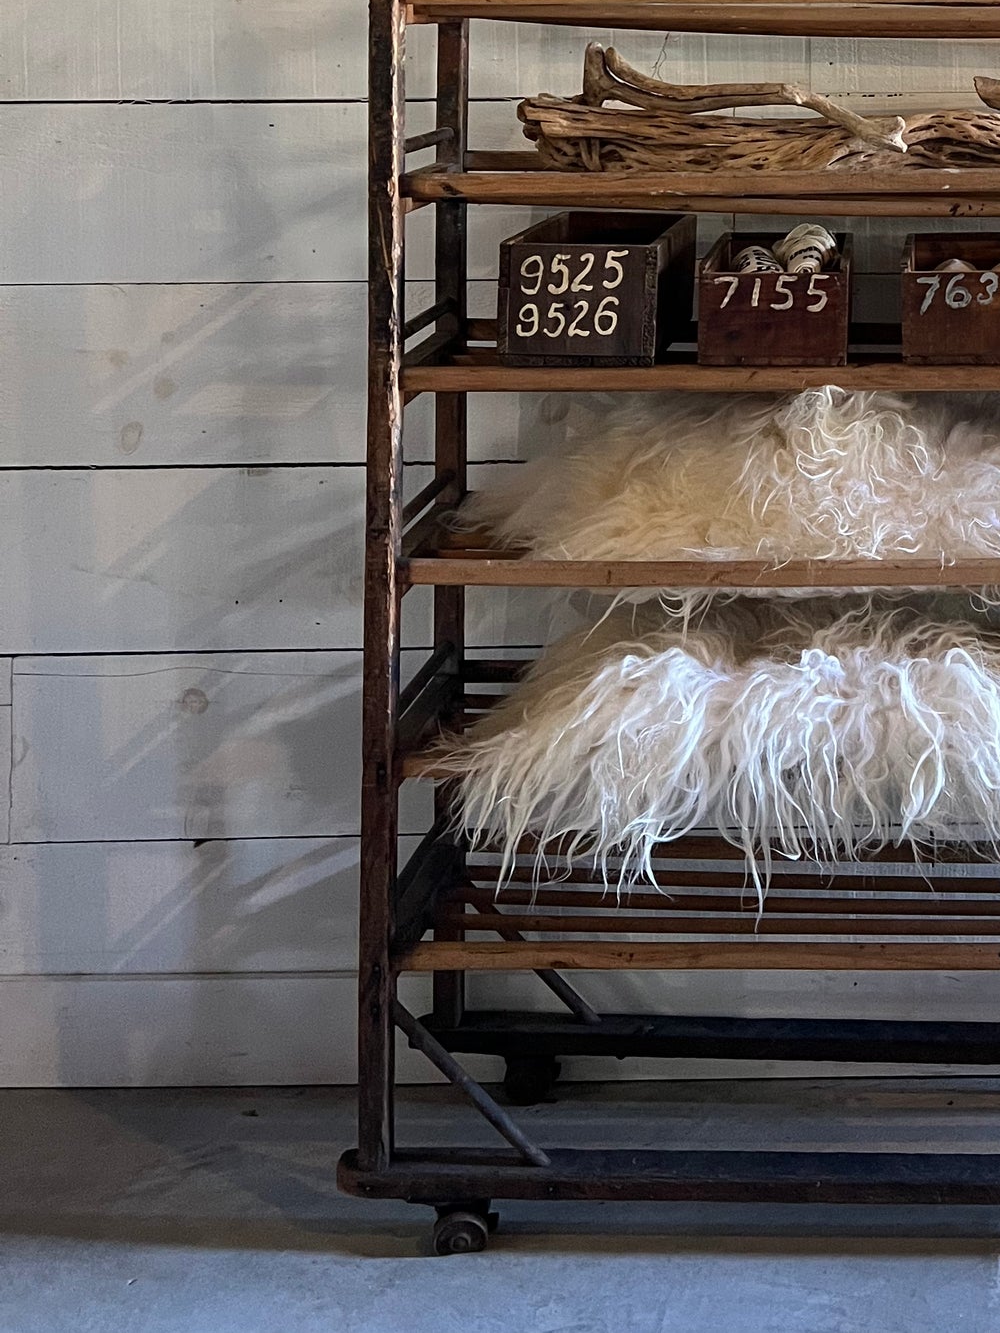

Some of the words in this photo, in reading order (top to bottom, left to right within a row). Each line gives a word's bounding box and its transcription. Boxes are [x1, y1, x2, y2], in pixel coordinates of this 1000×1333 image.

[520, 249, 629, 296] 9525
[713, 274, 830, 313] 7155
[516, 296, 620, 338] 9526
